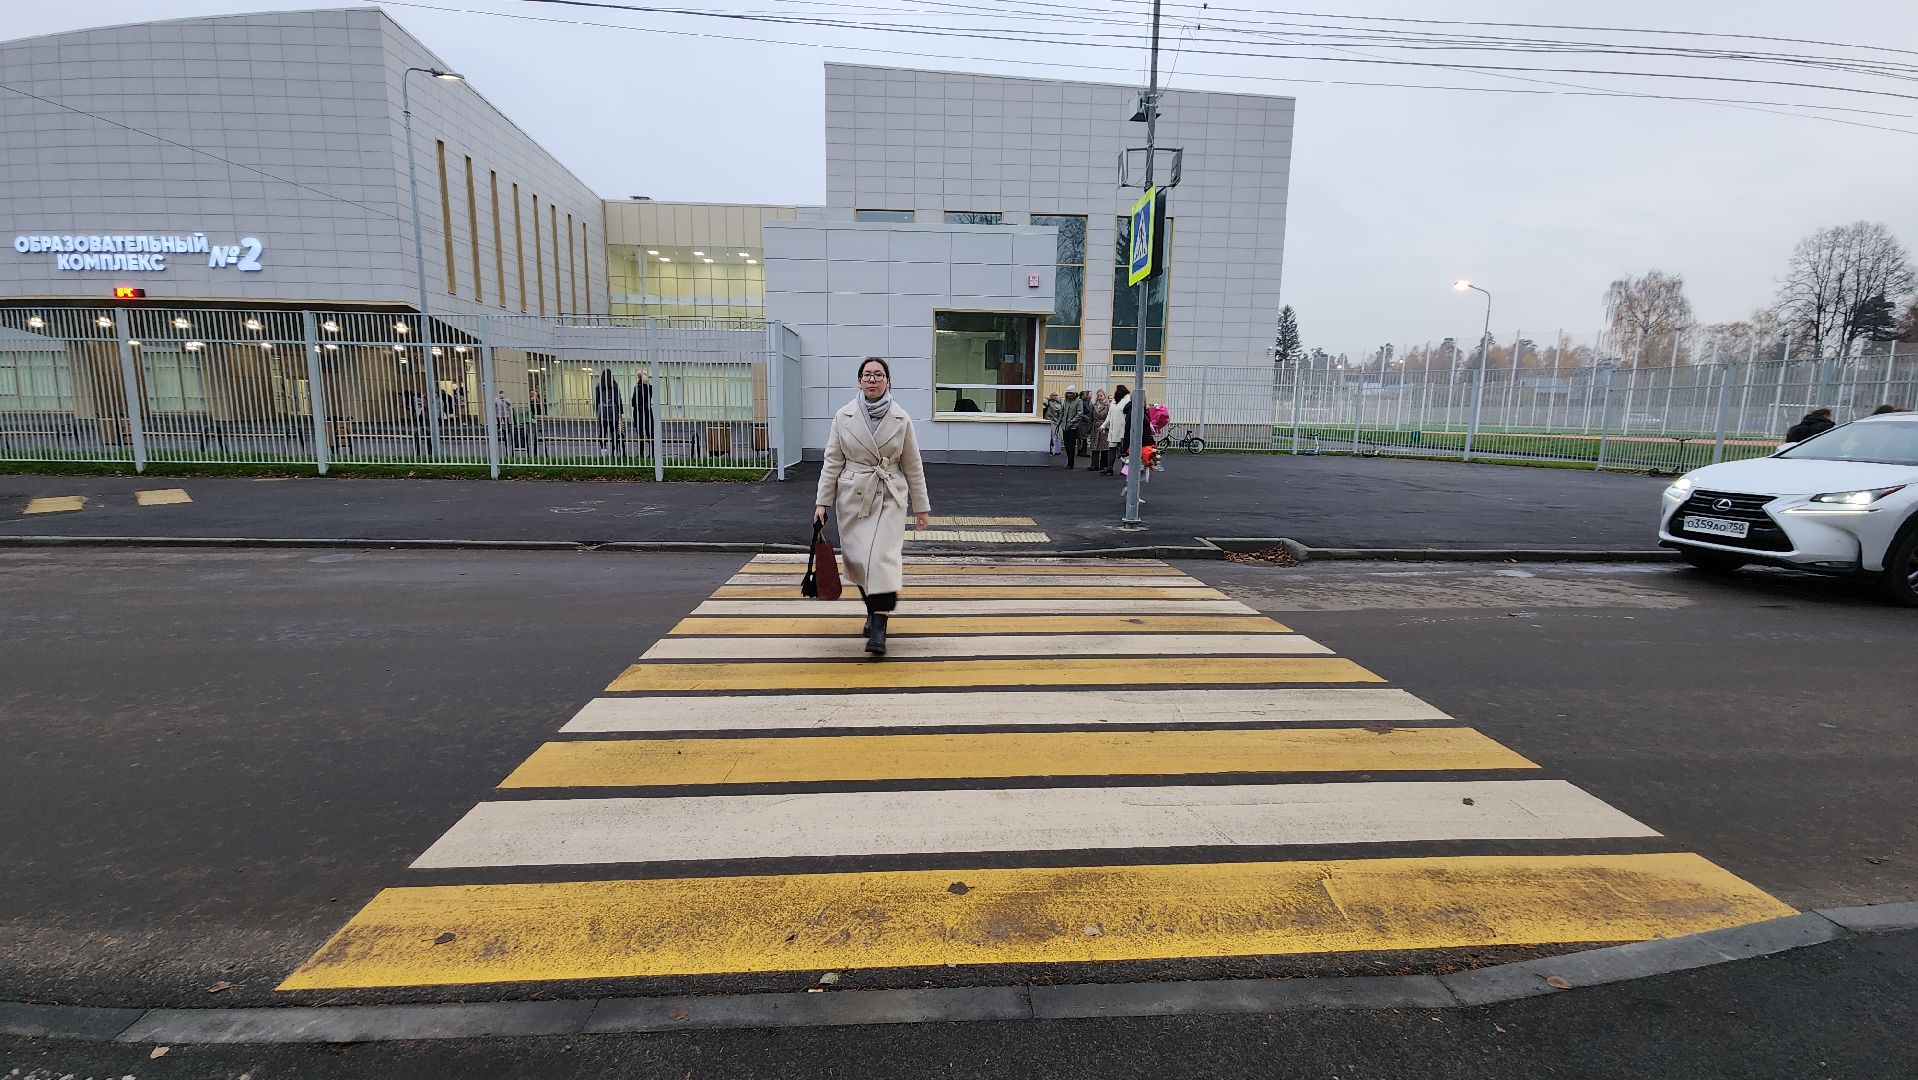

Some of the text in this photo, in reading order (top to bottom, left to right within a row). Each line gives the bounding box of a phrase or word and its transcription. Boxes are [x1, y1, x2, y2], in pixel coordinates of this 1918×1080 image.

[14, 233, 263, 271] ОБРАЗОВАТЕЛЬНЫЙ №2
[57, 254, 166, 271] КОМПЛЕКС
